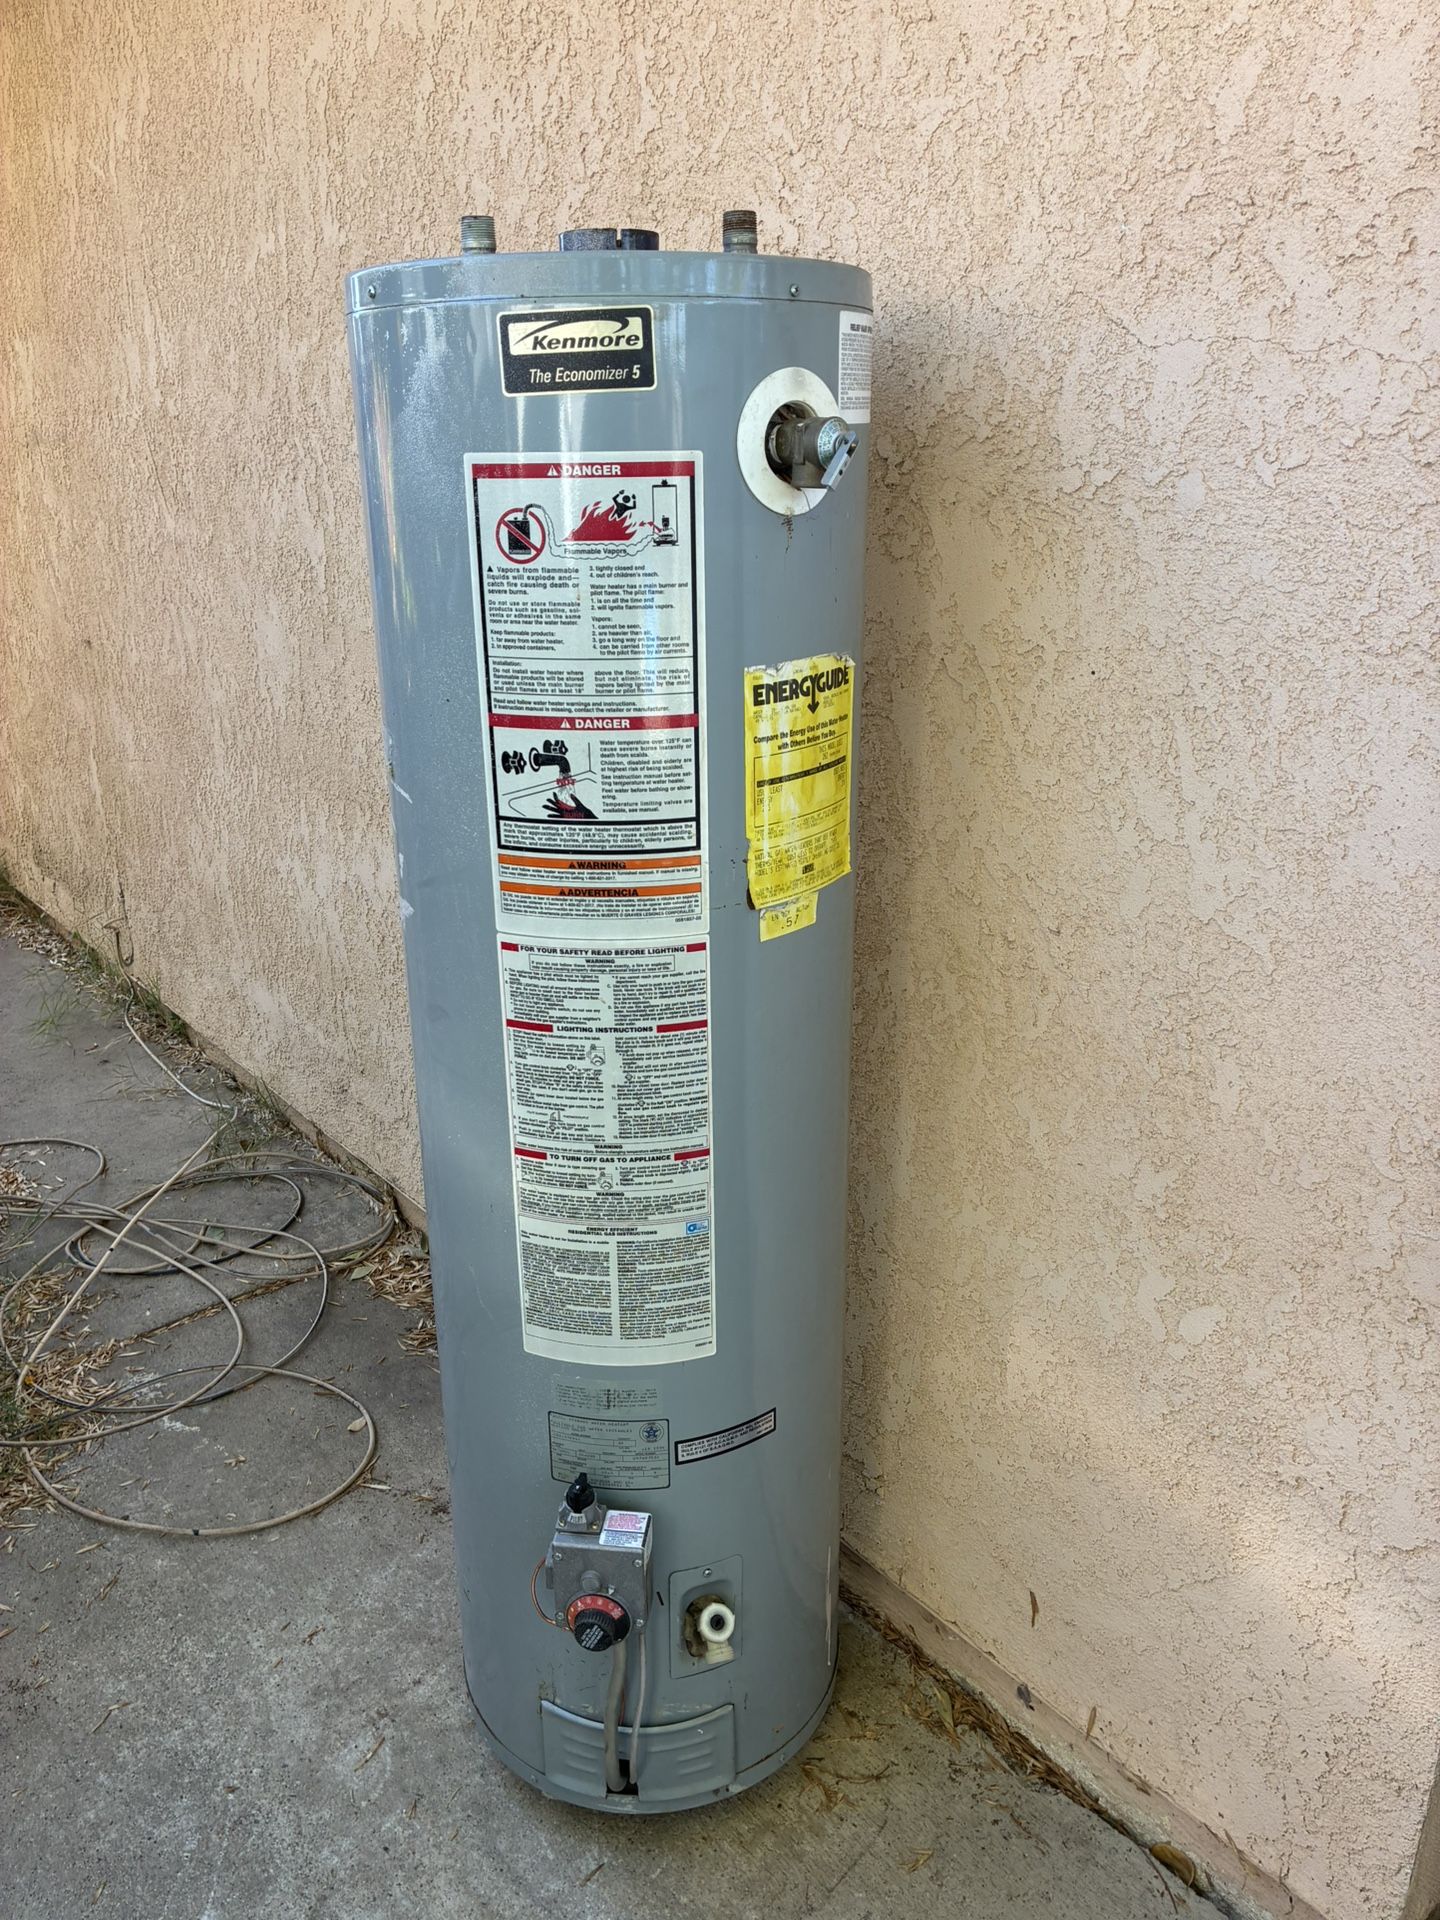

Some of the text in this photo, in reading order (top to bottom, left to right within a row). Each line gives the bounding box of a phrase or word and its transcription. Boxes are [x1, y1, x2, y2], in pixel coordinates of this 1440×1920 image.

[532, 334, 640, 350] Kenmore
[530, 365, 640, 383] The Economizer 5
[563, 465, 621, 476] DANGER
[753, 665, 849, 710] ENERGYGUIDE
[575, 719, 630, 728] DANGER
[754, 735, 778, 744] Compare
[780, 731, 788, 739] the
[790, 728, 806, 737] Energy
[816, 723, 821, 731] of
[829, 718, 838, 726] Water
[778, 742, 789, 750] with
[790, 738, 806, 748] Others
[807, 735, 820, 744] Before
[576, 861, 626, 870] WARNING
[568, 888, 639, 897] ADVERTENCIA
[557, 1025, 592, 1033] LIGHTING
